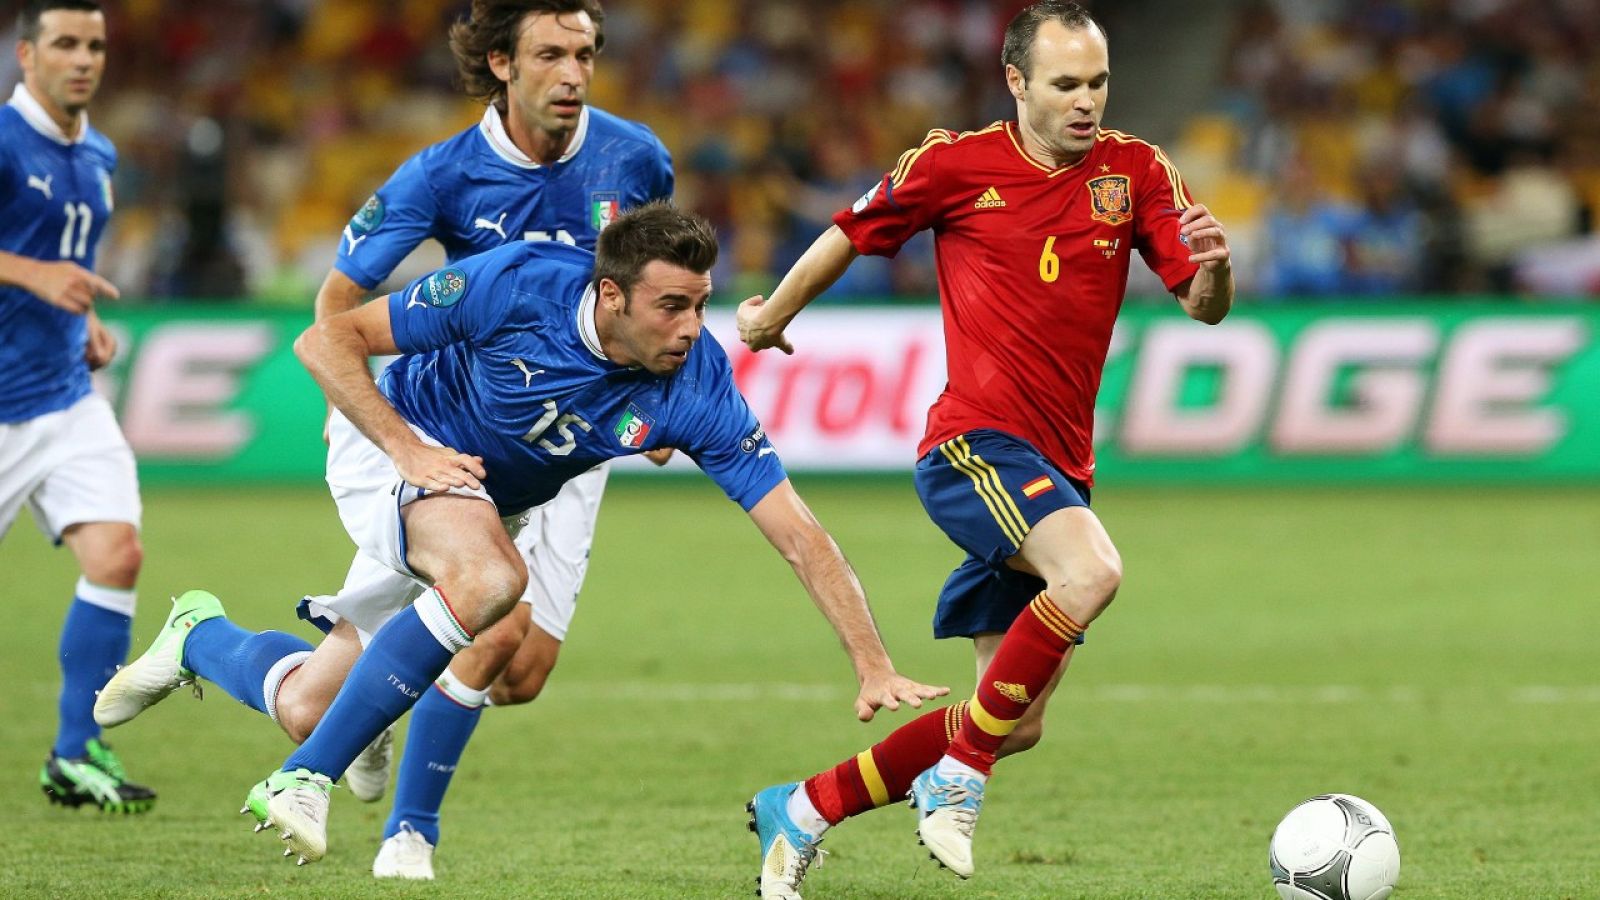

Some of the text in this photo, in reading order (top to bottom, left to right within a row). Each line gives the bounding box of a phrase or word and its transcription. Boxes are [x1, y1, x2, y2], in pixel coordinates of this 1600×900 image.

[59, 200, 92, 259] 11
[975, 199, 1006, 209] adidas
[1039, 235, 1060, 283] 6
[96, 319, 277, 459] E
[521, 400, 593, 456] 15
[387, 674, 419, 698] ITALIA
